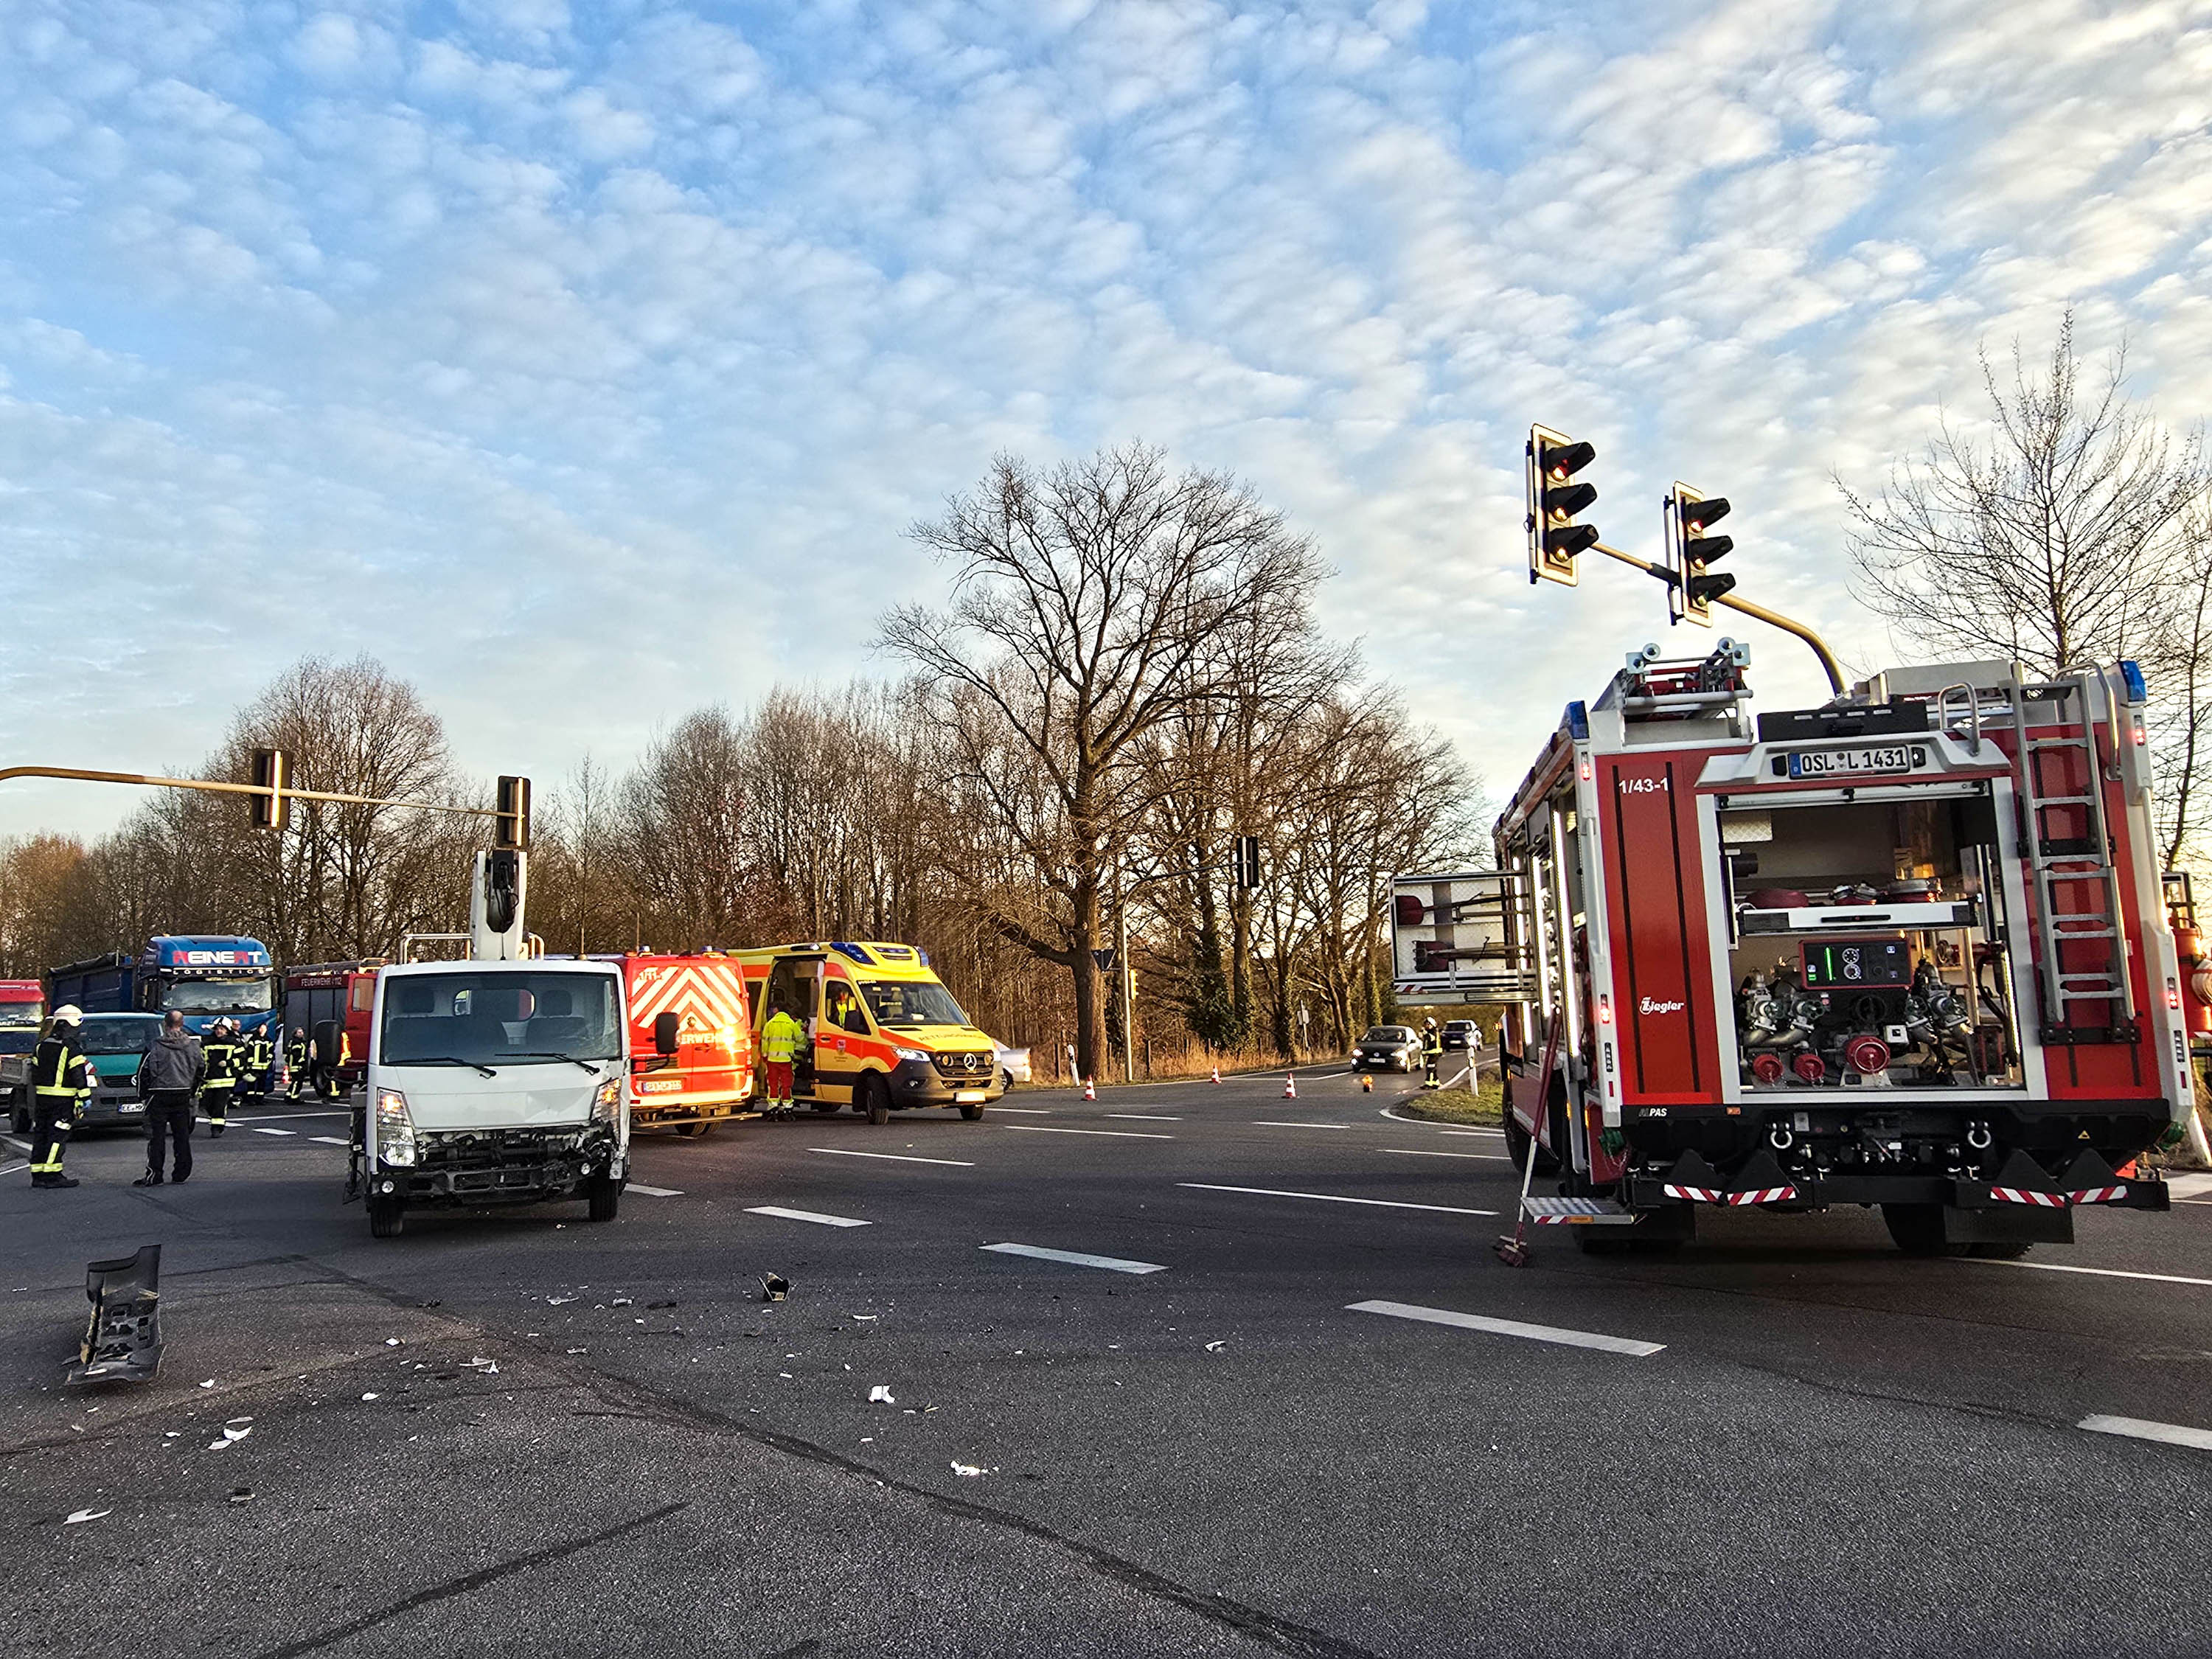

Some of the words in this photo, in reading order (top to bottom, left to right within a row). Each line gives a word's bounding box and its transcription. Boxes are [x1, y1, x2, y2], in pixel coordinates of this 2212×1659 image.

[1802, 754, 1834, 772] OSL
[1848, 752, 1859, 769] L
[1863, 749, 1906, 768] 1431
[1618, 777, 1669, 794] 1/43-1
[1639, 997, 1685, 1015] Ziegler
